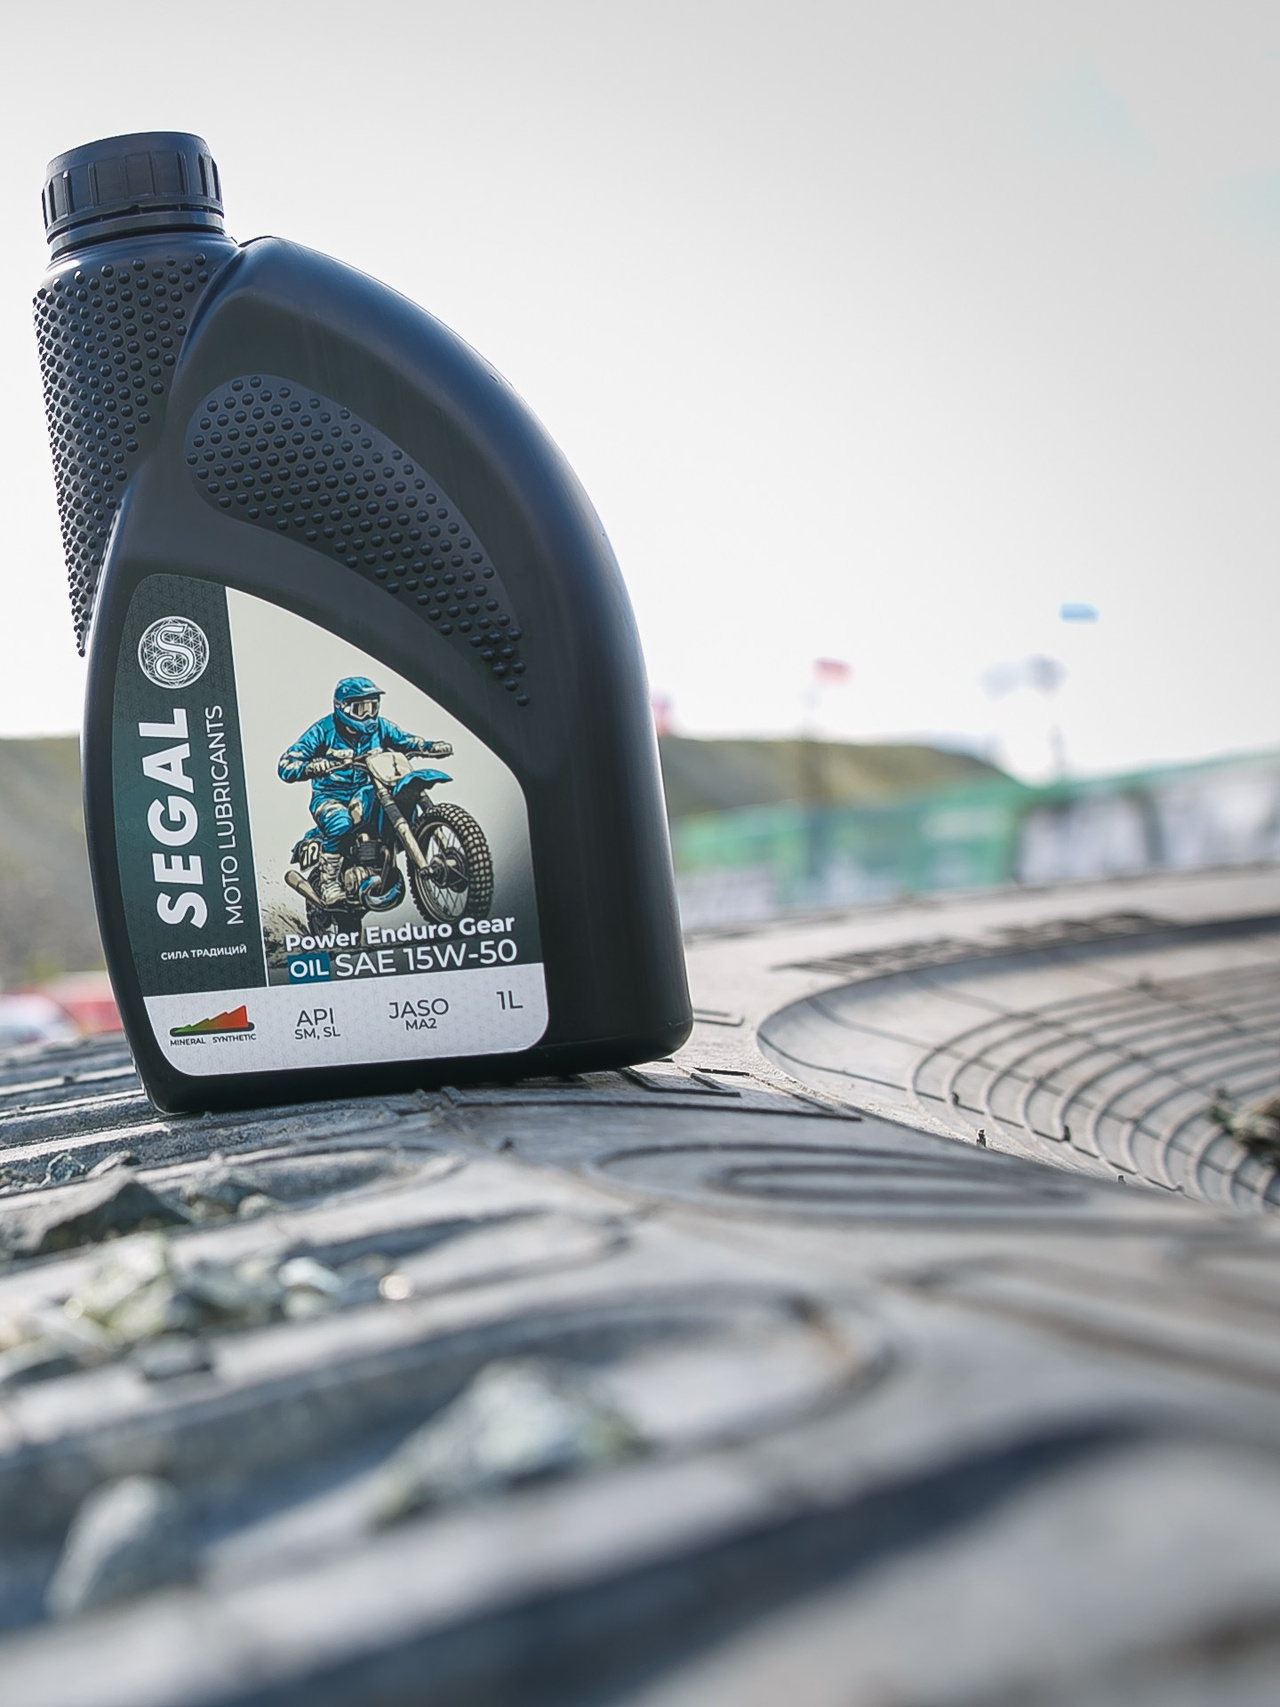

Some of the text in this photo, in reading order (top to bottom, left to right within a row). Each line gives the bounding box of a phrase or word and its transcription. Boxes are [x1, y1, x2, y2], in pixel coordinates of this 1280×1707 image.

[137, 707, 208, 929] SEGAL
[205, 704, 245, 925] MOTO LUBRICANTS
[285, 916, 515, 952] Power Enduro Gear
[160, 943, 247, 961] СИЛА ТРАДИЦИЙ
[290, 938, 518, 978] OIL SAE 15W-50
[388, 997, 449, 1020] JASO
[496, 989, 523, 1011] 1L
[296, 1007, 335, 1027] API
[405, 1018, 438, 1031] MA2
[170, 1033, 257, 1047] MINERAL SYNTHETIC
[294, 1026, 341, 1041] SM, SL
